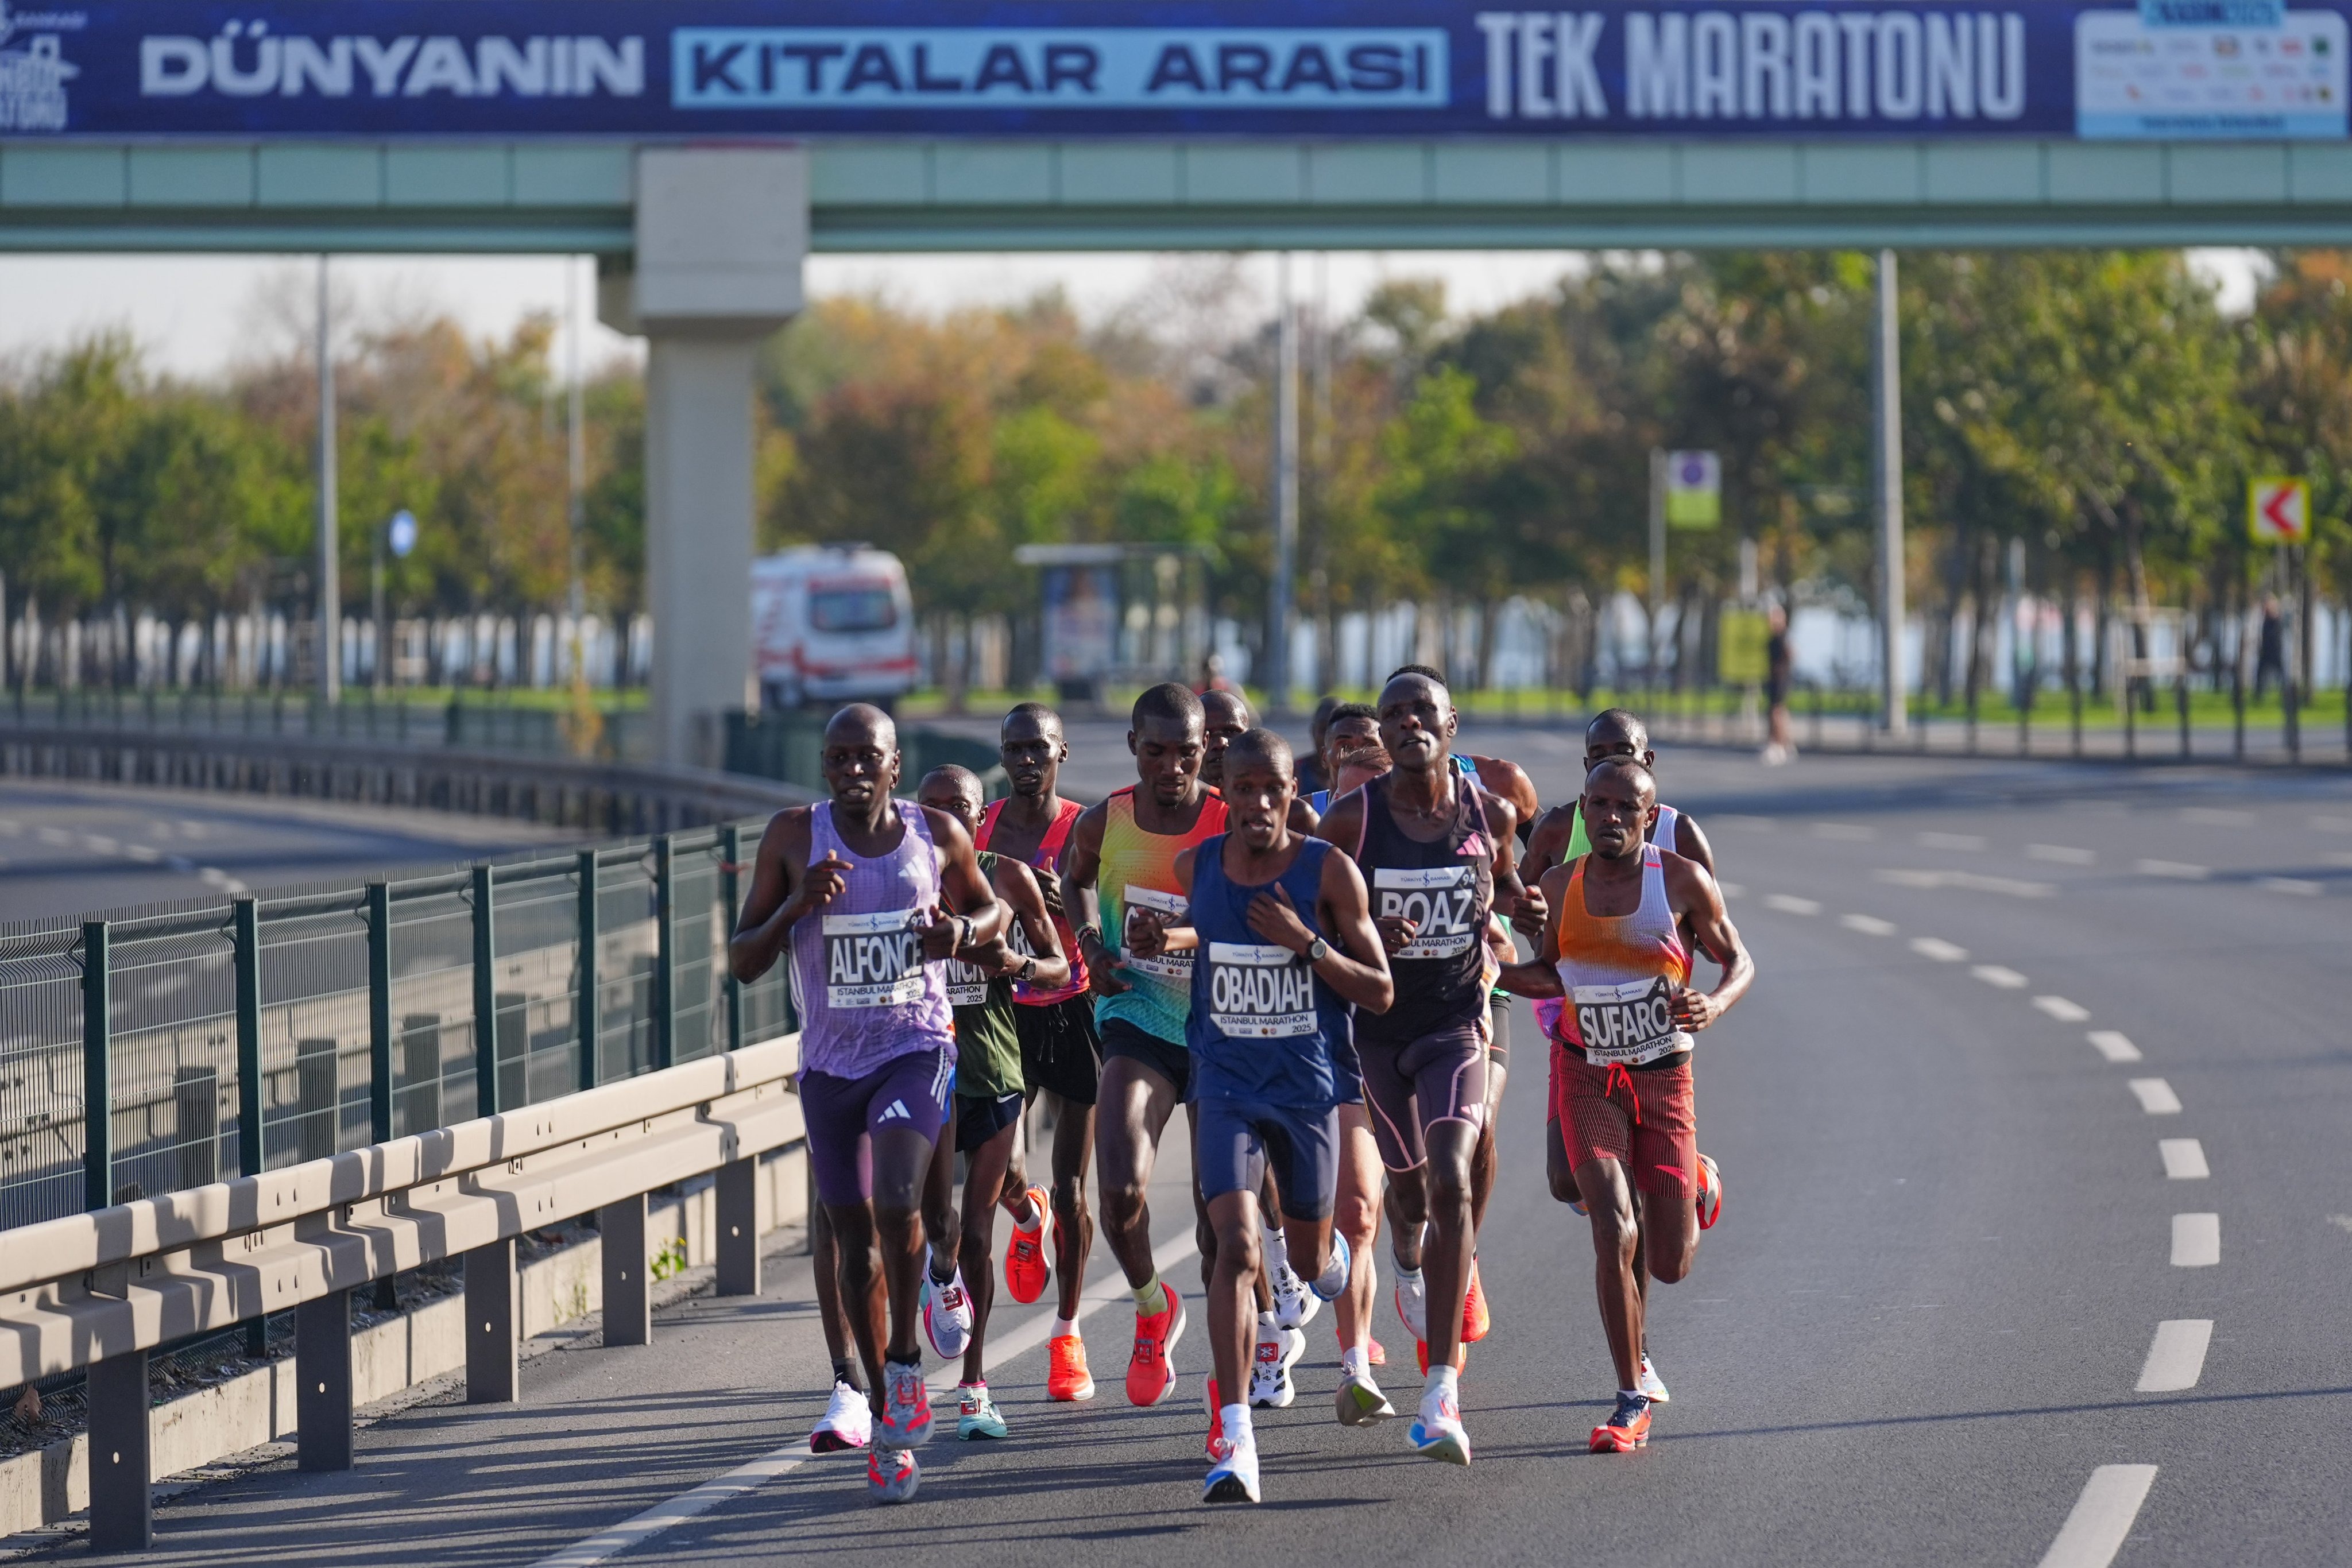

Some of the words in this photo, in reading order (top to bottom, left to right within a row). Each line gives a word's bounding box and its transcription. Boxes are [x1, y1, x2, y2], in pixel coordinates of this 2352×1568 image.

[140, 19, 644, 96] DÜNYANIN
[691, 41, 1102, 95] KITALAR
[1143, 41, 1431, 95] ARASI
[1475, 11, 1607, 118] TEK
[1624, 10, 2026, 119] MARATONU
[1463, 873, 1476, 885] 94
[1381, 889, 1472, 936] BOAZ
[1422, 936, 1467, 947] MARATHON
[830, 932, 923, 984] ALFONCE
[837, 986, 876, 996] ISTANBUL
[877, 979, 918, 994] MARATHON
[946, 986, 981, 994] ARATHON
[1212, 965, 1314, 1013] OBADIAH
[1658, 982, 1665, 992] 4
[966, 994, 983, 1003] 2025
[1220, 1016, 1258, 1025] ISTANBUL
[1259, 1013, 1308, 1025] MARATHON
[1579, 996, 1671, 1047] SUFARO
[1292, 1023, 1312, 1033] 2025
[1593, 1049, 1628, 1057] ISTANBUL
[1628, 1035, 1672, 1055] MARATHON
[1658, 1043, 1676, 1056] 2025
